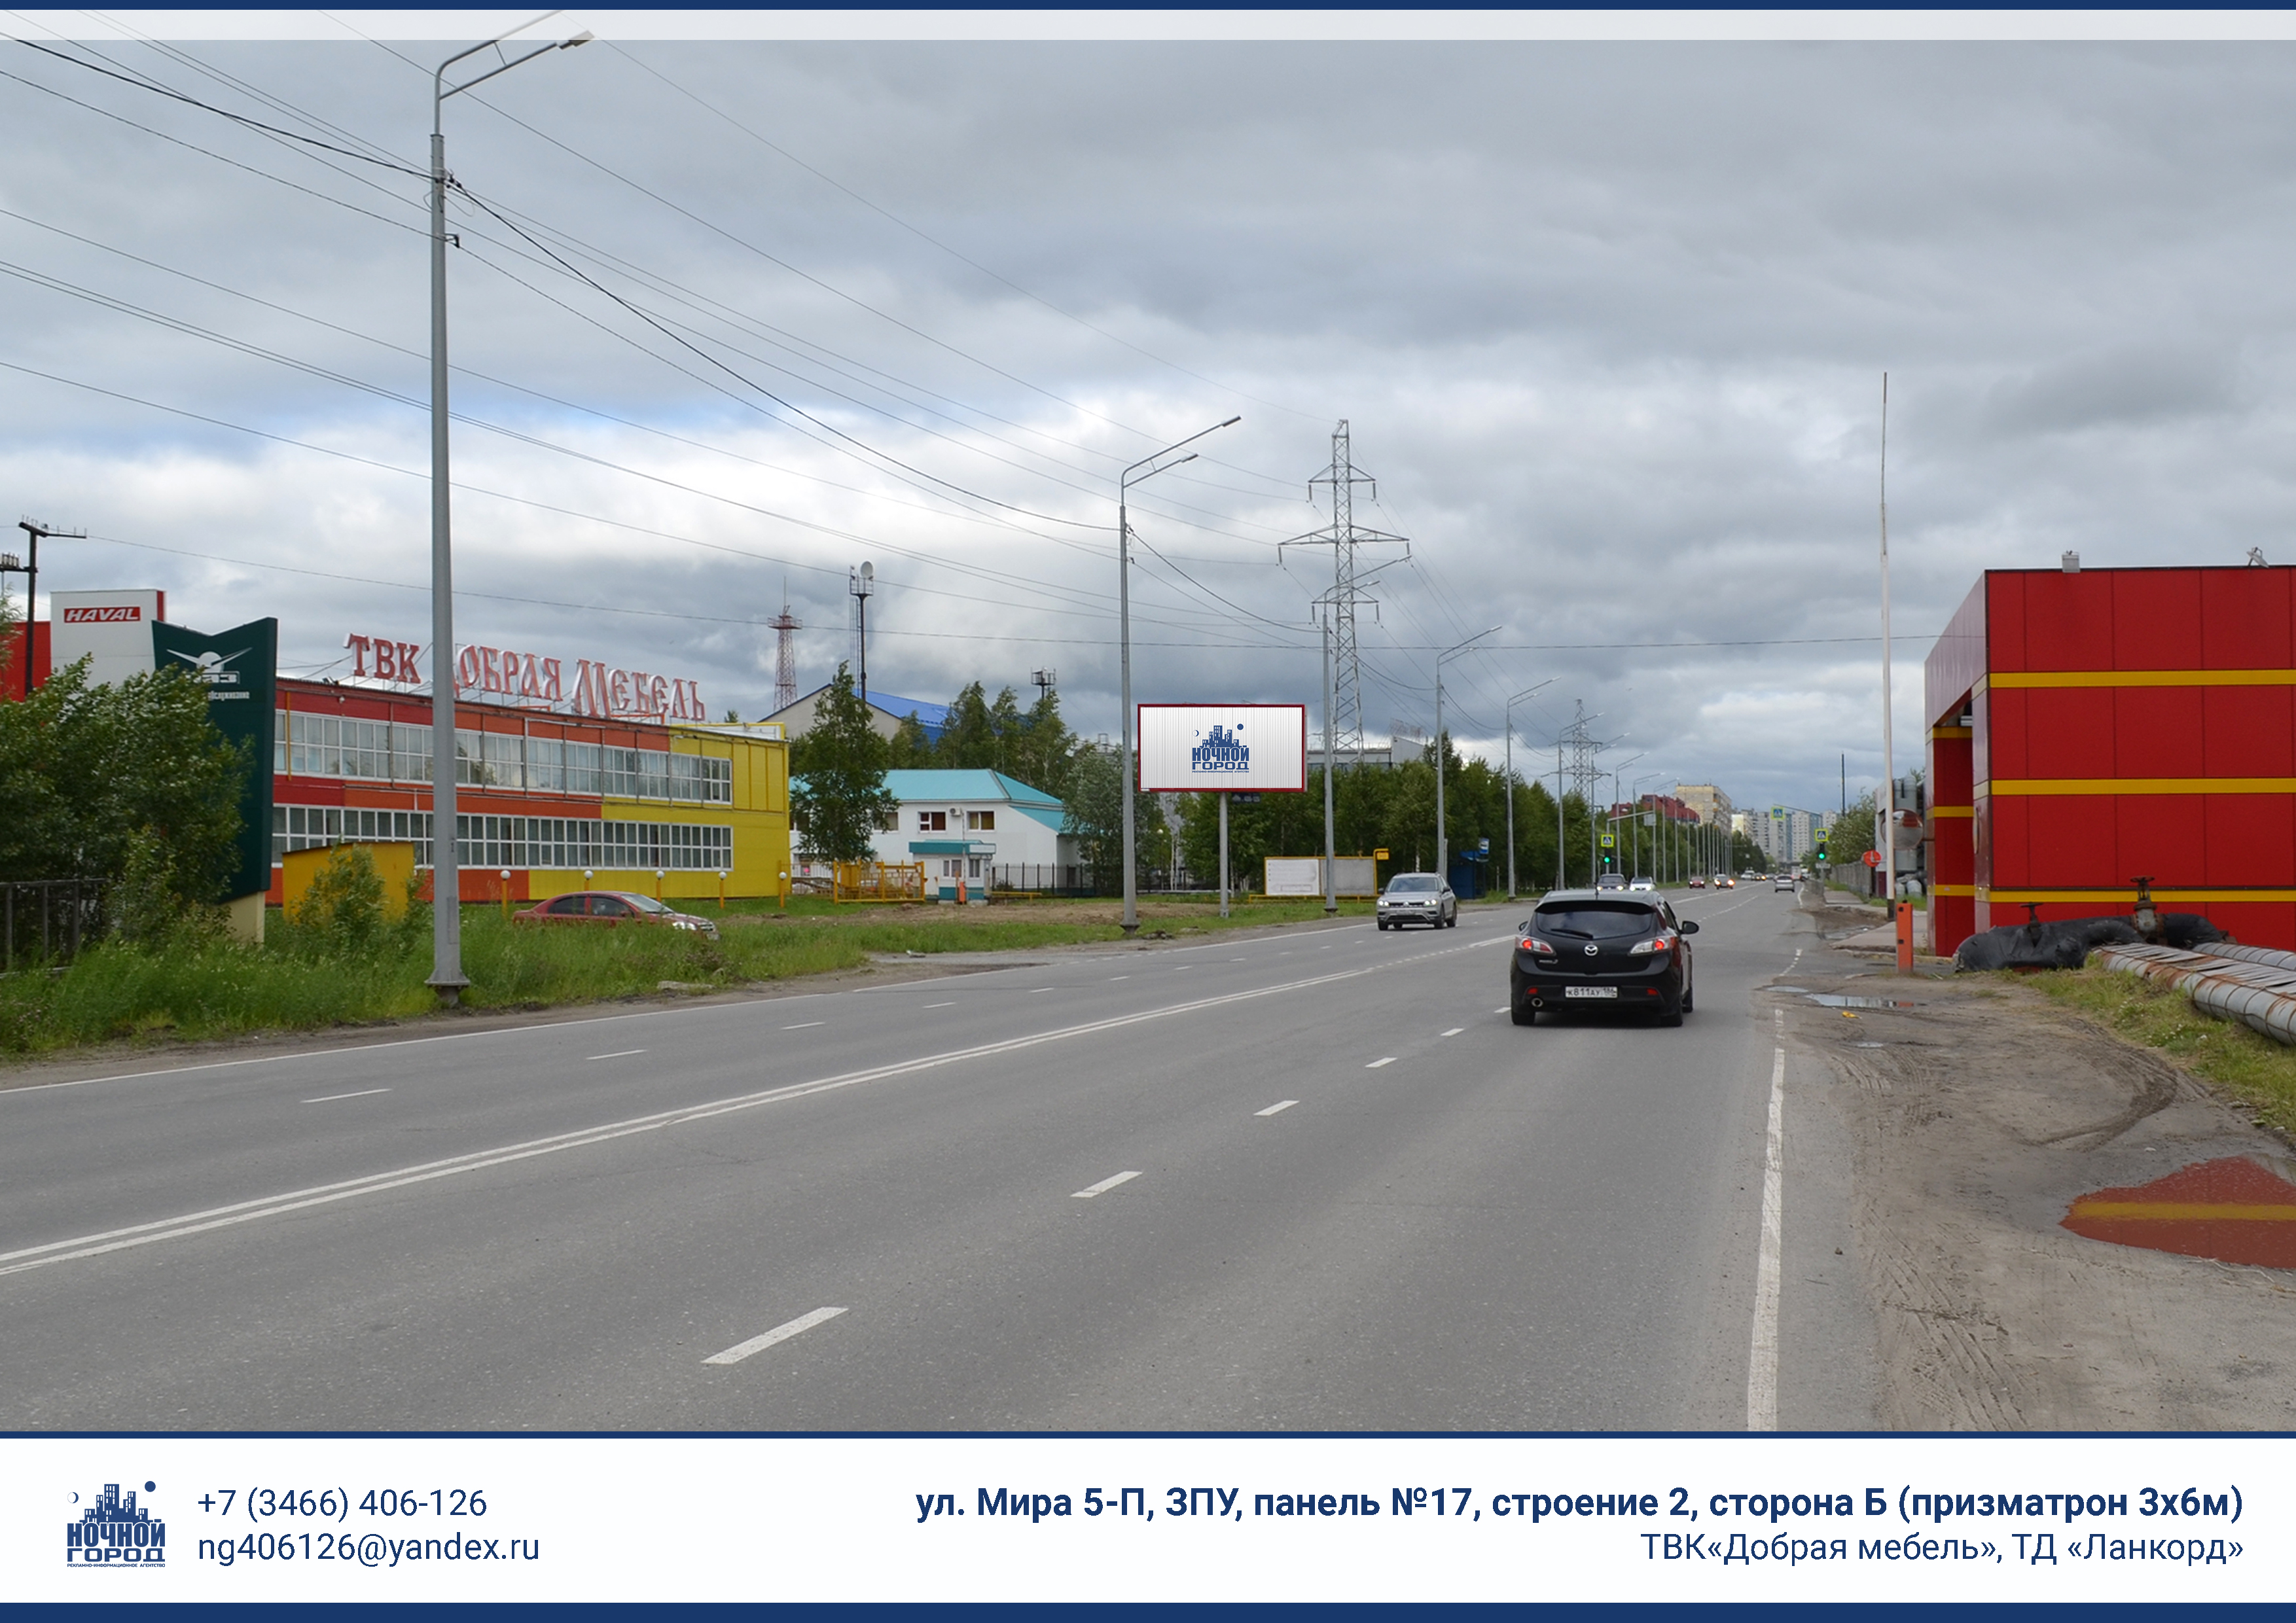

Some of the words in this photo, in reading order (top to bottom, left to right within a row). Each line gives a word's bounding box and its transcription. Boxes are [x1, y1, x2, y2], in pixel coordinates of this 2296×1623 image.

[66, 609, 139, 621] HAVAL
[343, 632, 421, 685] ТВК
[453, 645, 563, 702] ОБРАЯ
[1193, 745, 1249, 761] НОЧНОЙ
